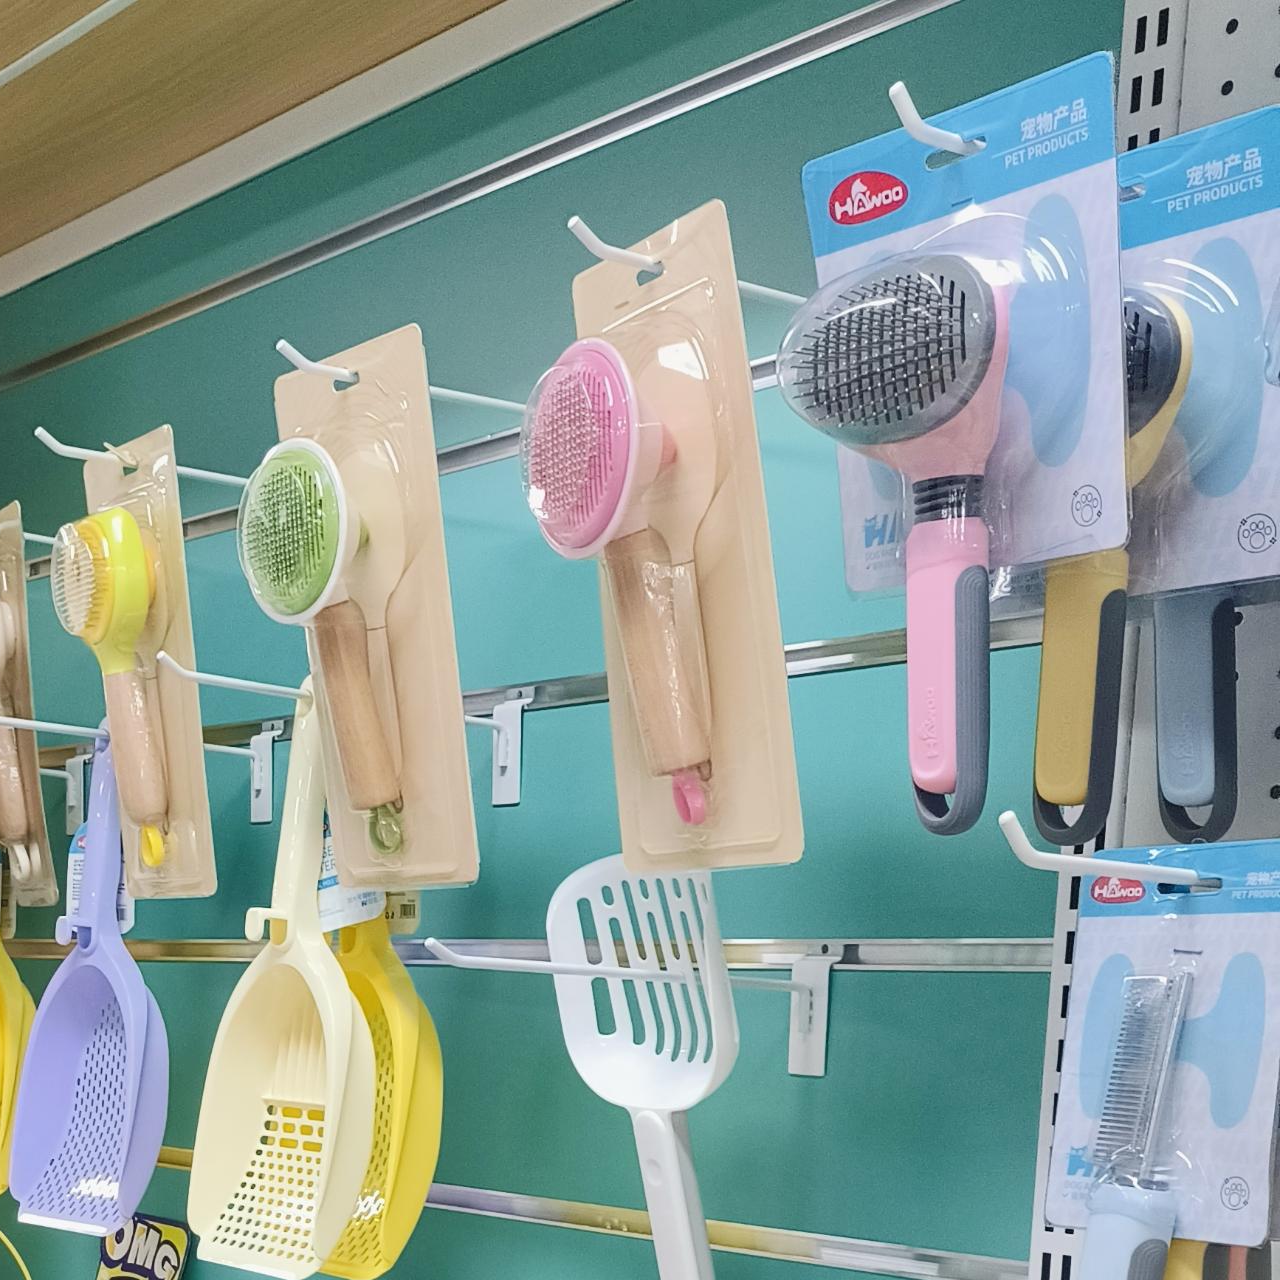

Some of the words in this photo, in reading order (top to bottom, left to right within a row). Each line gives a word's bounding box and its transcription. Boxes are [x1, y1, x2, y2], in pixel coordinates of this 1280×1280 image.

[1021, 97, 1087, 142] 宠物产品
[1004, 149, 1025, 169] PET
[1027, 126, 1088, 160] PRODUCTS
[1185, 147, 1262, 189] 宠物产品
[1167, 195, 1190, 213] PET
[1193, 174, 1263, 206] PRODUCTS
